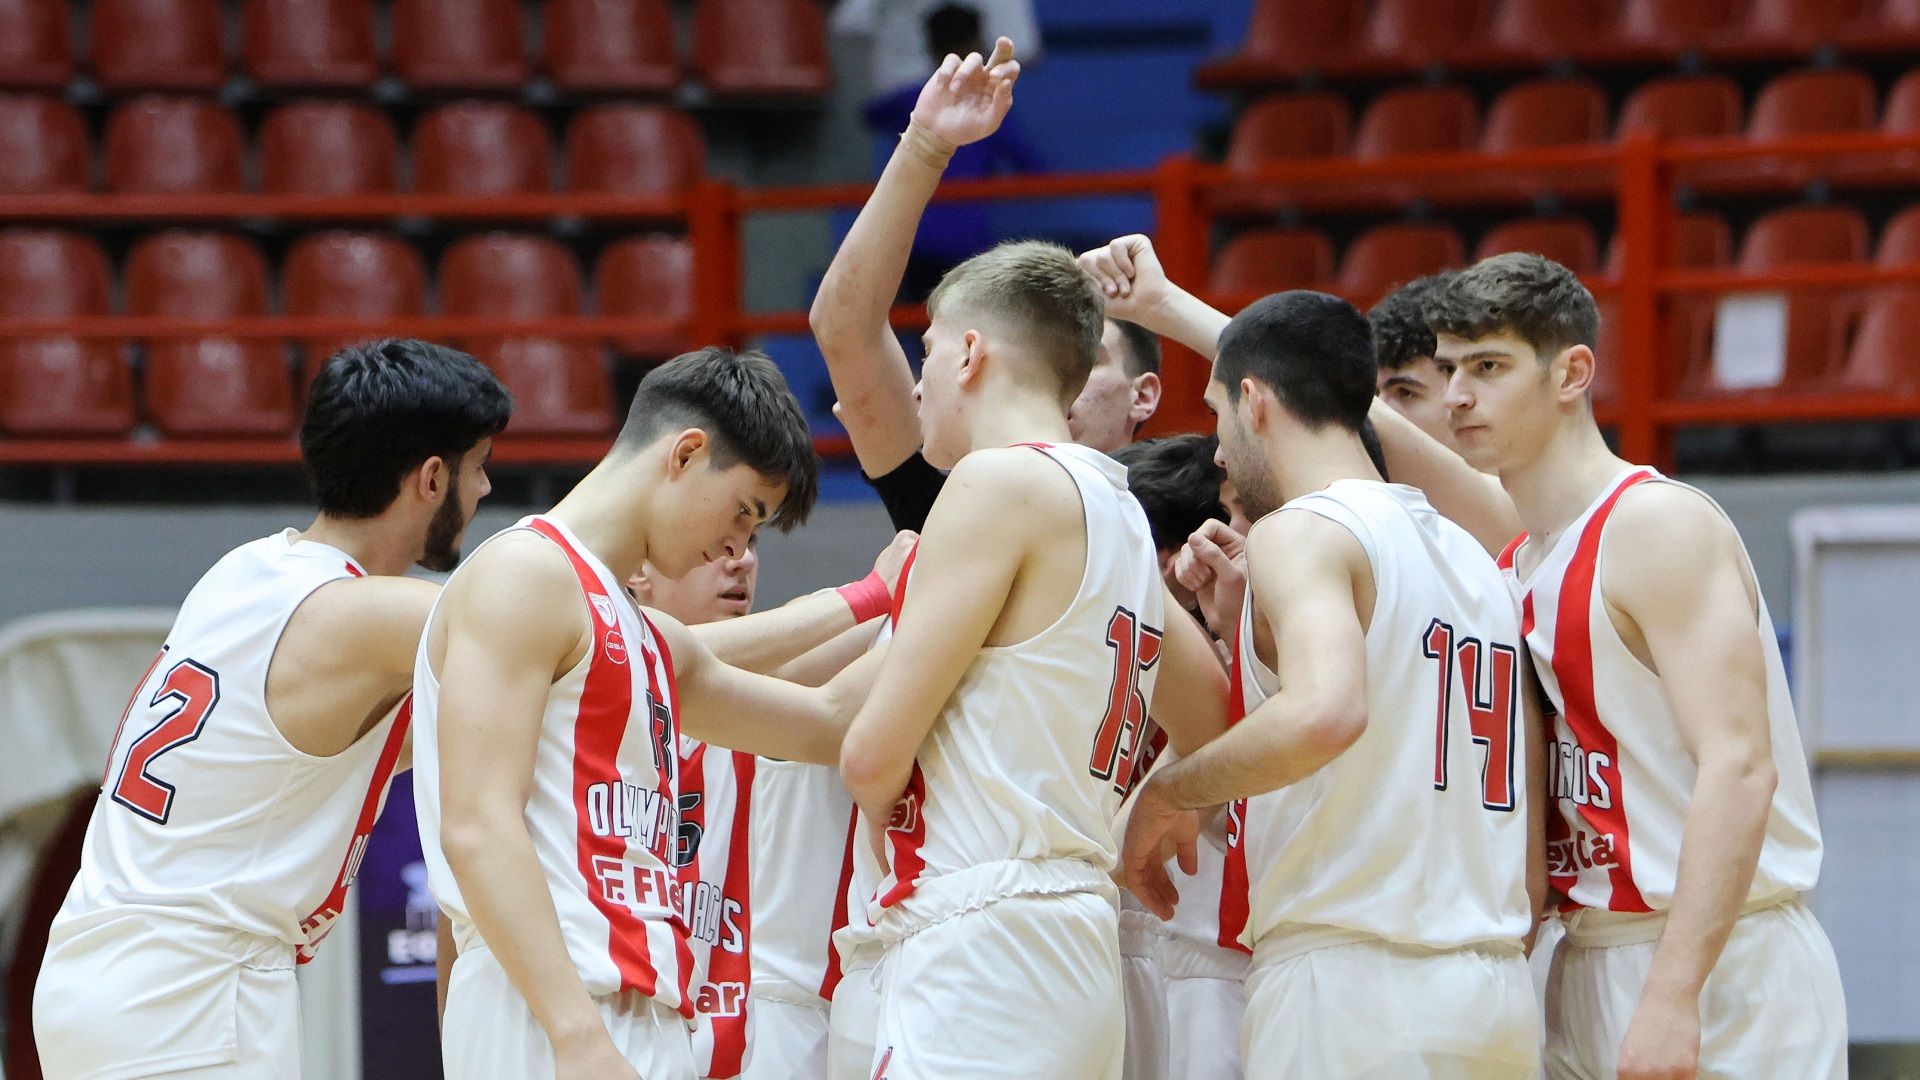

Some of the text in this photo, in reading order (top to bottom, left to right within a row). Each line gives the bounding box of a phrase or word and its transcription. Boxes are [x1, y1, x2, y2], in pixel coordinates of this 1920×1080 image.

[1089, 605, 1163, 797] 15
[1422, 617, 1516, 812] 14
[696, 983, 744, 1016] ar
